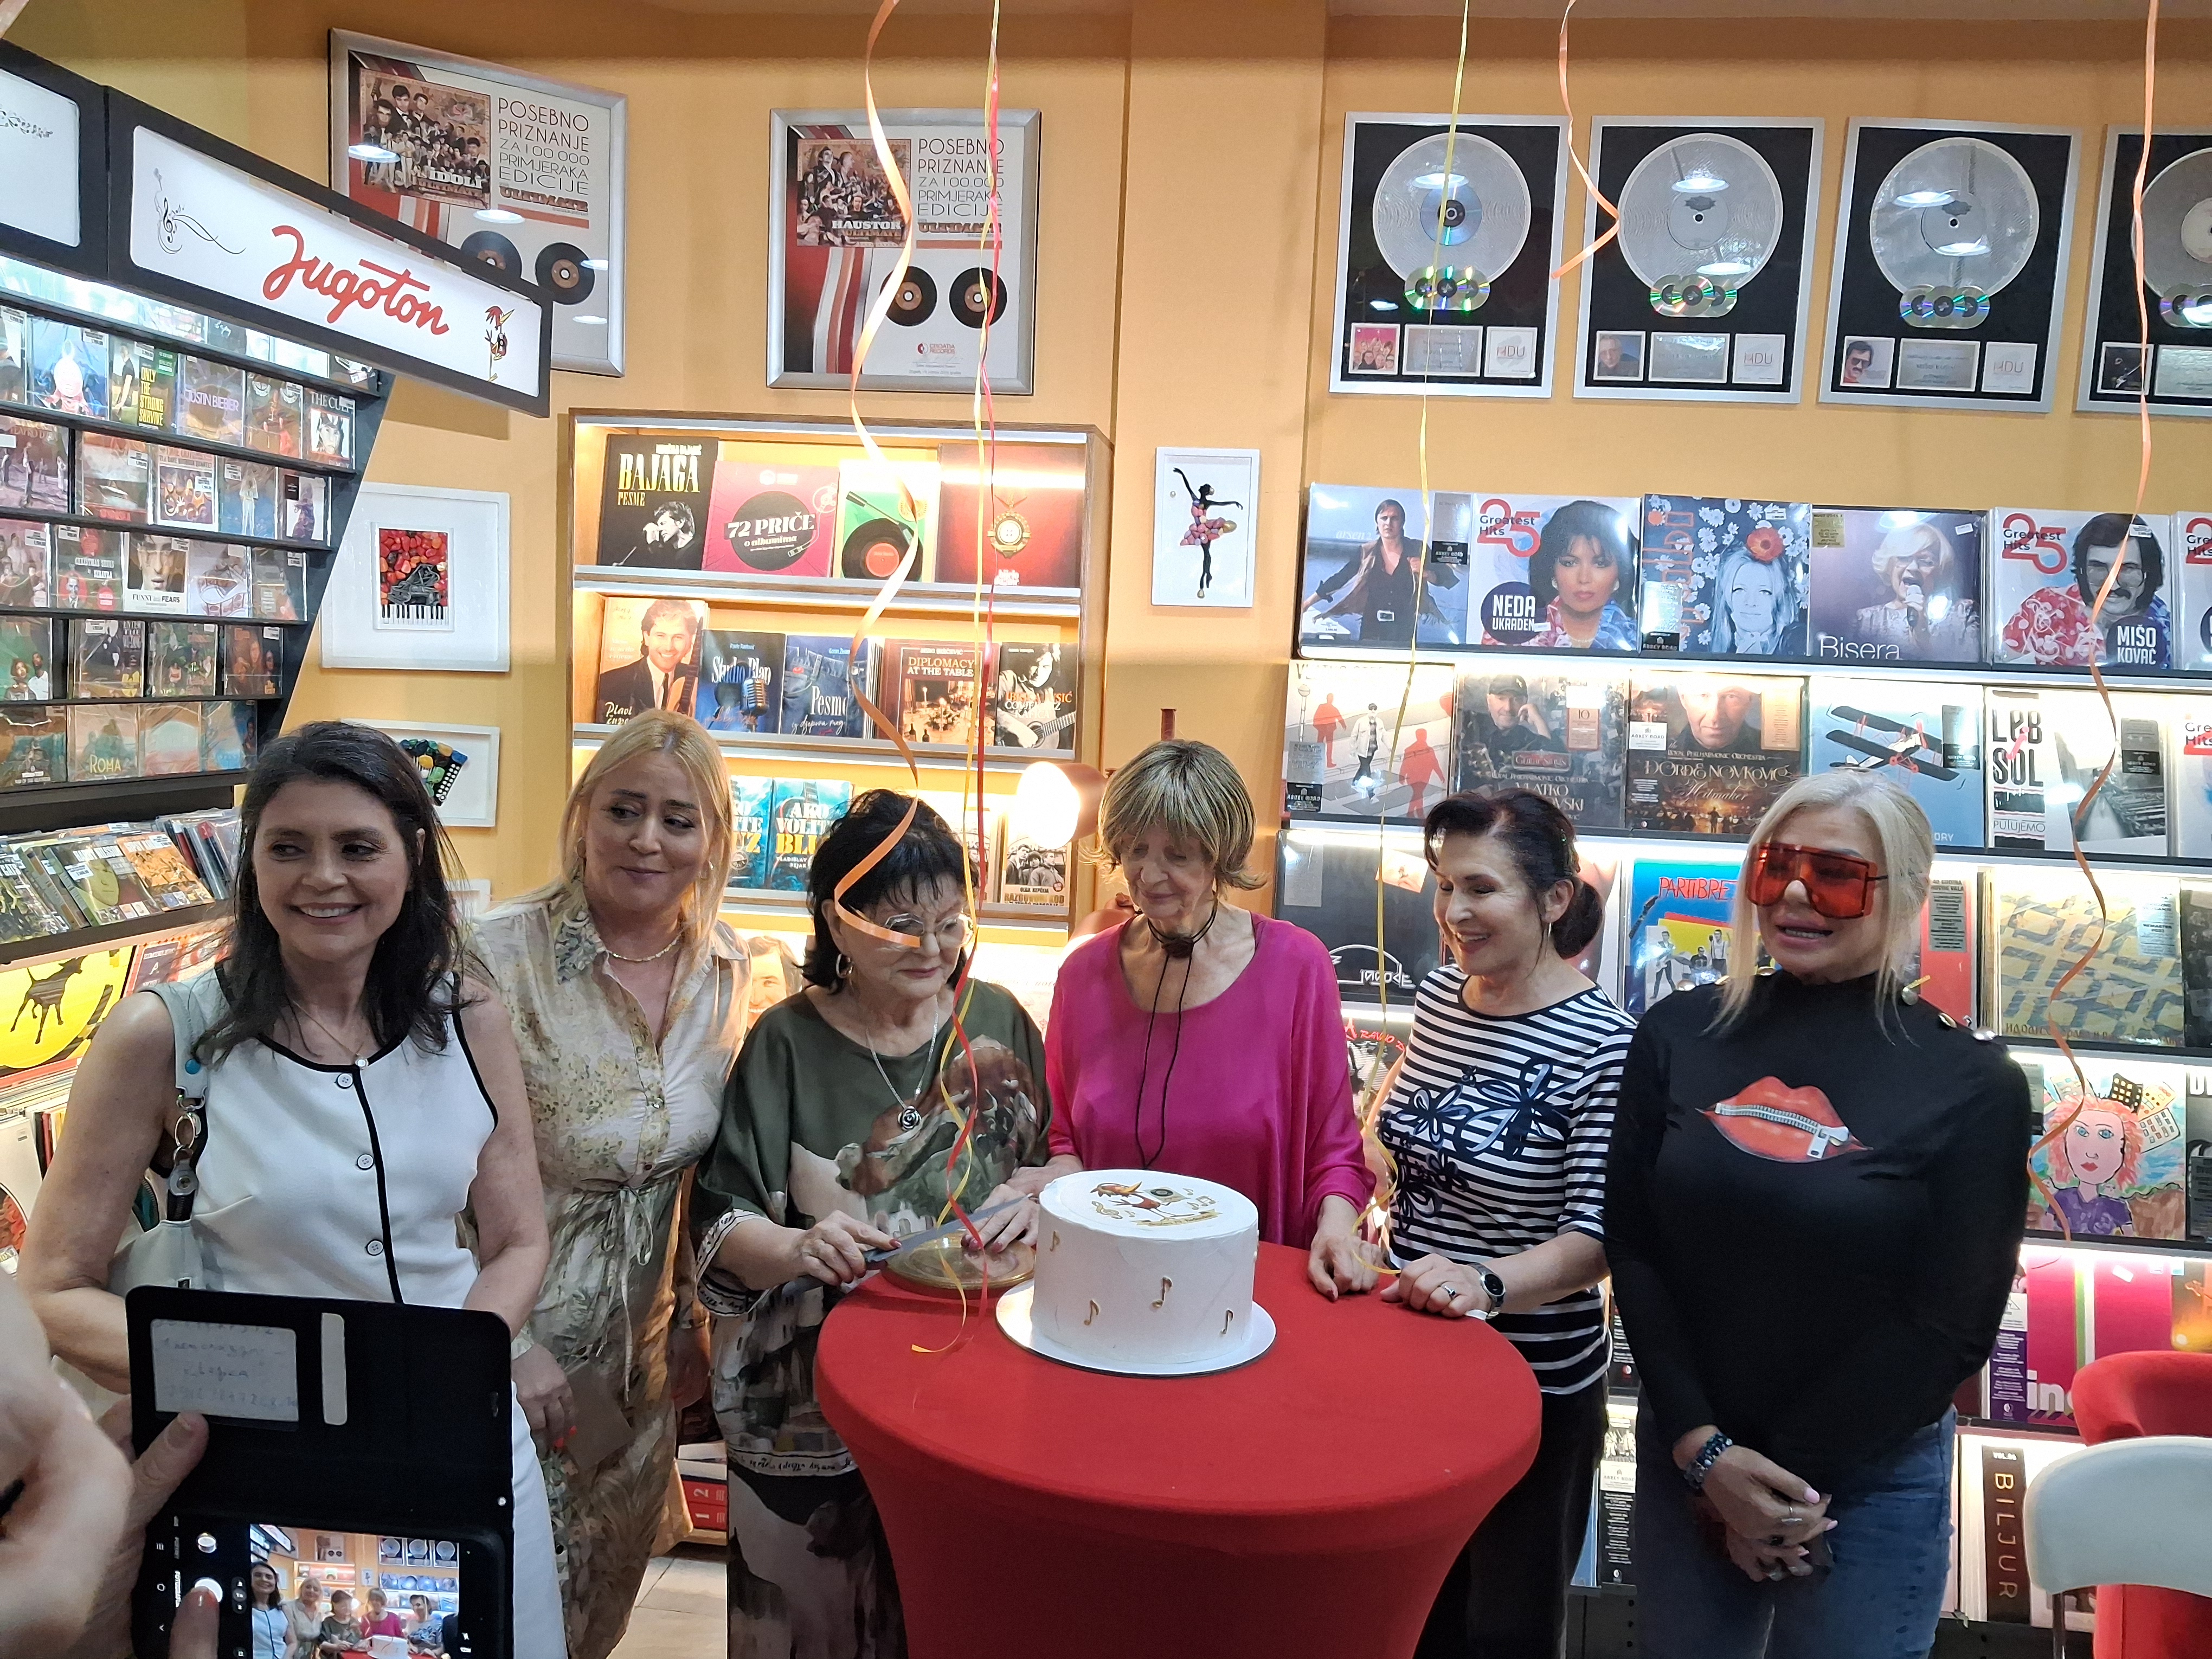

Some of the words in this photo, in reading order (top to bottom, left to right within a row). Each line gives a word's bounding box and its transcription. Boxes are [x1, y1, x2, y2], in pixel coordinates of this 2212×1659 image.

[498, 97, 590, 132] POSEBNO
[499, 119, 589, 152] PRIZNANJE
[499, 137, 520, 152] ZA
[499, 152, 588, 181] PRIMJERAKA
[918, 159, 1004, 174] PRIZNANE
[499, 167, 589, 196] EDICIJE
[918, 177, 937, 188] ZA
[832, 220, 902, 230] HAUSTOR
[263, 225, 449, 336] Jugoton
[140, 366, 156, 383] ONLY
[140, 381, 151, 396] THE
[139, 395, 164, 409] STRONG
[311, 391, 327, 407] THE
[139, 409, 163, 426] SURVIVE
[619, 453, 700, 493] BAJAGA
[618, 491, 645, 506] PESME
[727, 520, 751, 538] 72
[754, 511, 816, 537] PRIČE
[1480, 515, 1535, 526] Greatest
[1480, 526, 1504, 536] Hits
[2003, 528, 2062, 541] Greatest
[2003, 540, 2030, 551] Hits
[161, 596, 181, 604] FEARS
[1493, 594, 1536, 617] NEDA
[1492, 617, 1535, 631] UKRADEN
[2117, 624, 2156, 647] MIŠO
[908, 657, 975, 669] DIPLOMACY
[907, 666, 919, 674] AT
[921, 666, 942, 676] THE
[944, 667, 975, 678] TABLE
[89, 754, 122, 774] ROMA
[1992, 747, 2044, 787] SOL
[1933, 833, 1954, 841] ORY
[1659, 877, 1739, 901] PARTIBRE
[1994, 1472, 2018, 1599] BILJUR
